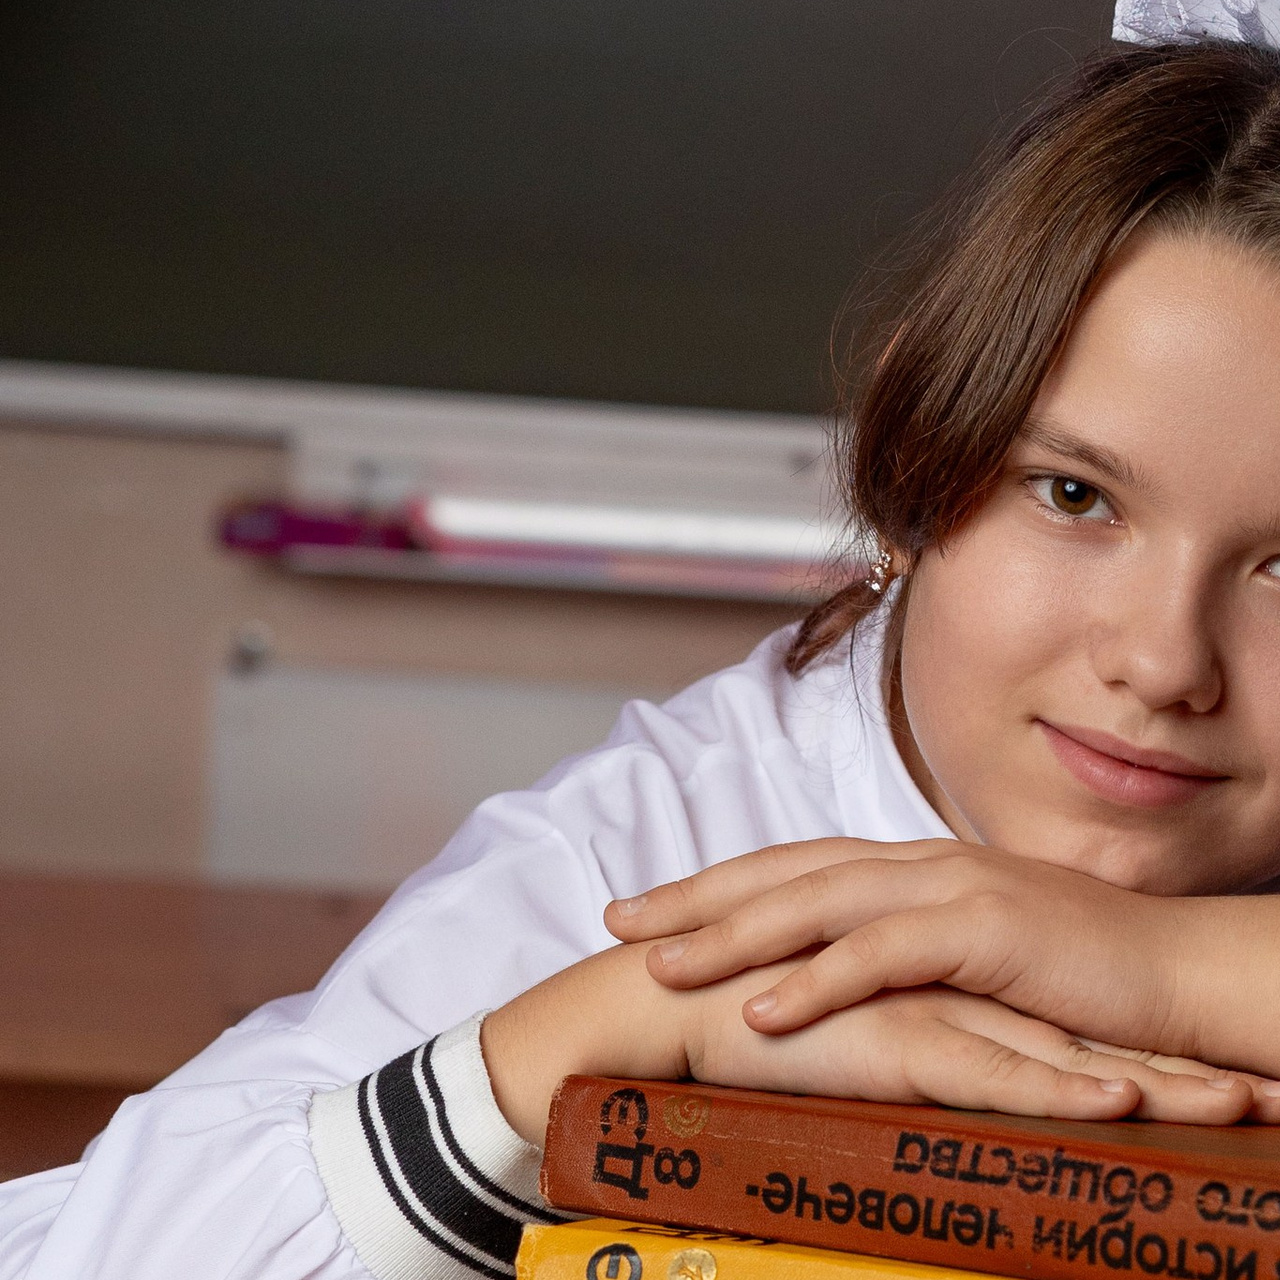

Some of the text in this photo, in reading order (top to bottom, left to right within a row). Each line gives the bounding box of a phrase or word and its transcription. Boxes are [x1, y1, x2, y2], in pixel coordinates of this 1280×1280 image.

[593, 1087, 654, 1201] ДЭ
[653, 1146, 701, 1190] 8
[892, 1130, 1174, 1223] общества
[745, 1170, 1014, 1250] человече-
